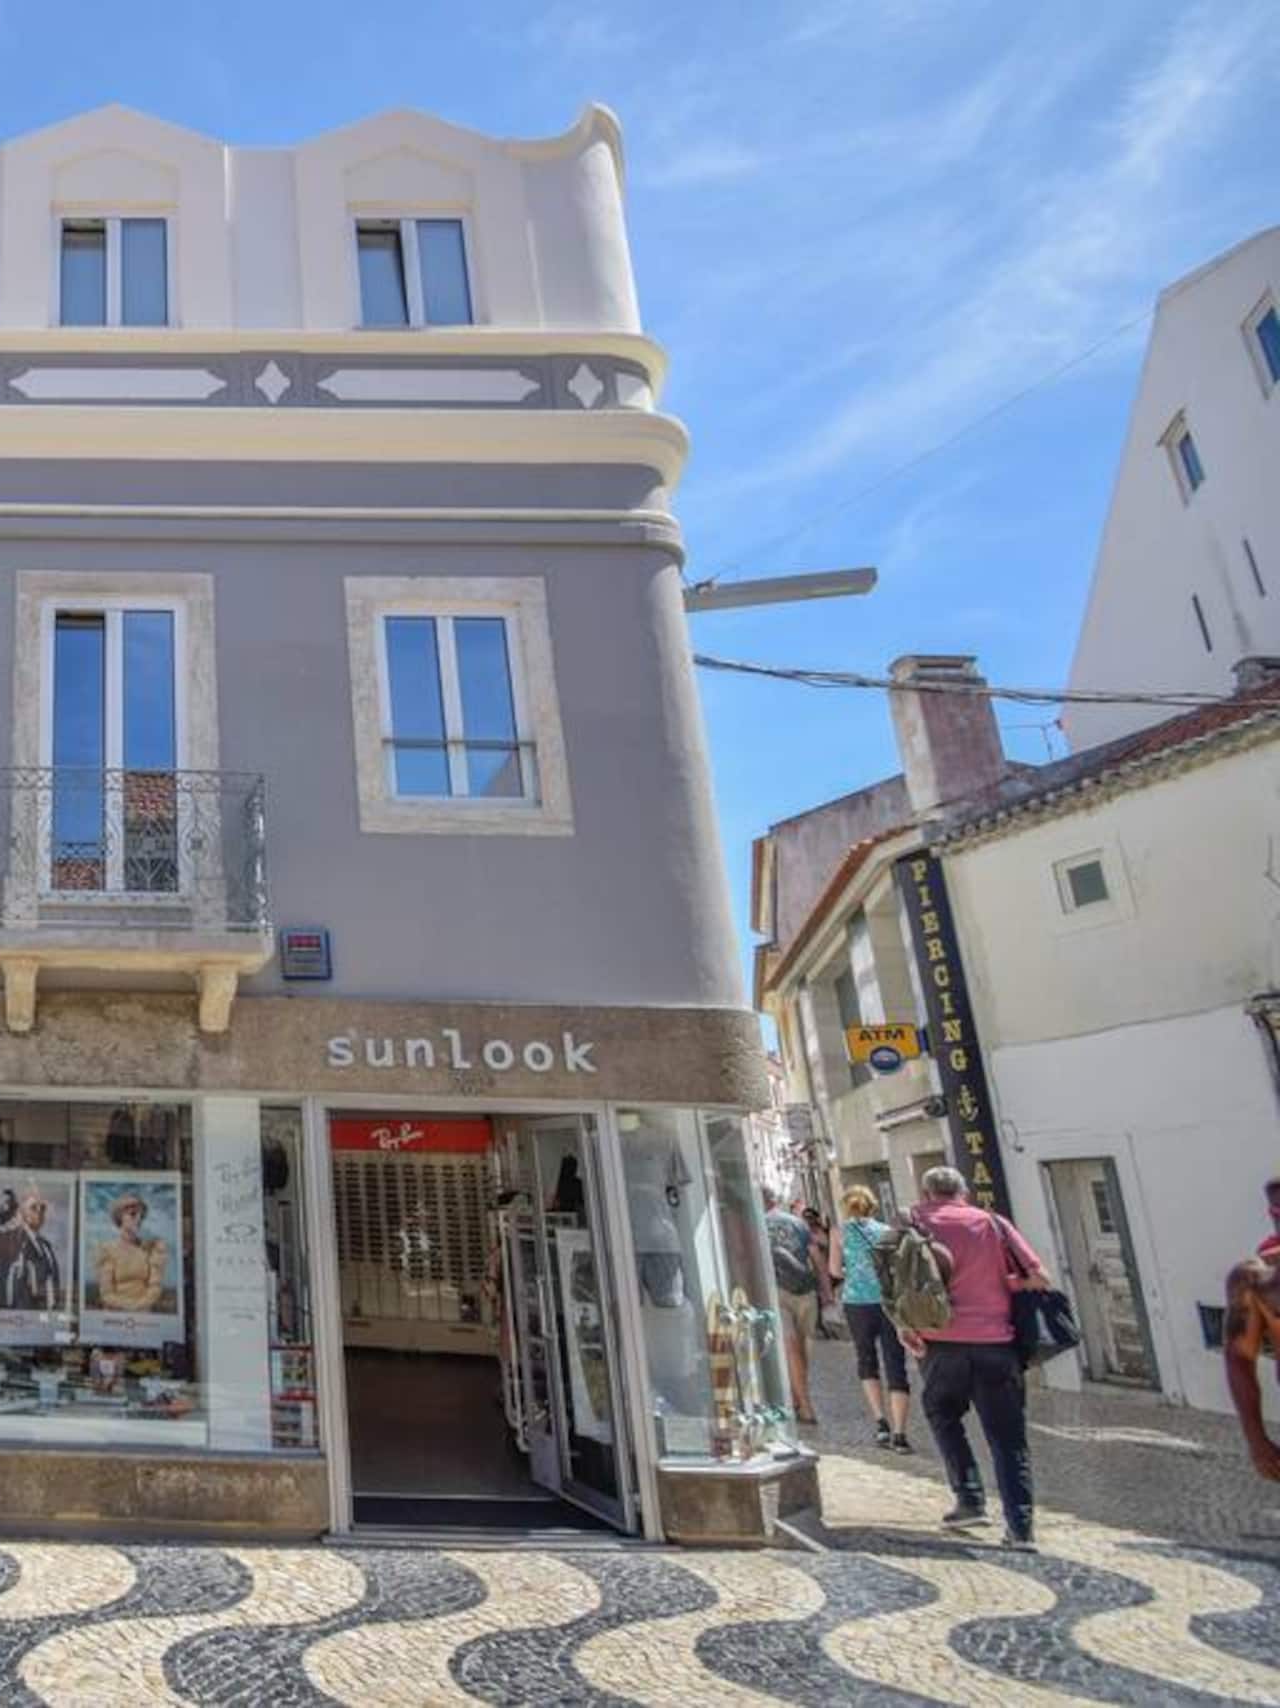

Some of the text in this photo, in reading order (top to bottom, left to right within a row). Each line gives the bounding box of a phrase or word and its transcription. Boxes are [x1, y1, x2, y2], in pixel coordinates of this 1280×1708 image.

[910, 860, 970, 1073] PIERCING
[327, 1028, 598, 1073] sunlook
[859, 1028, 905, 1041] ATM
